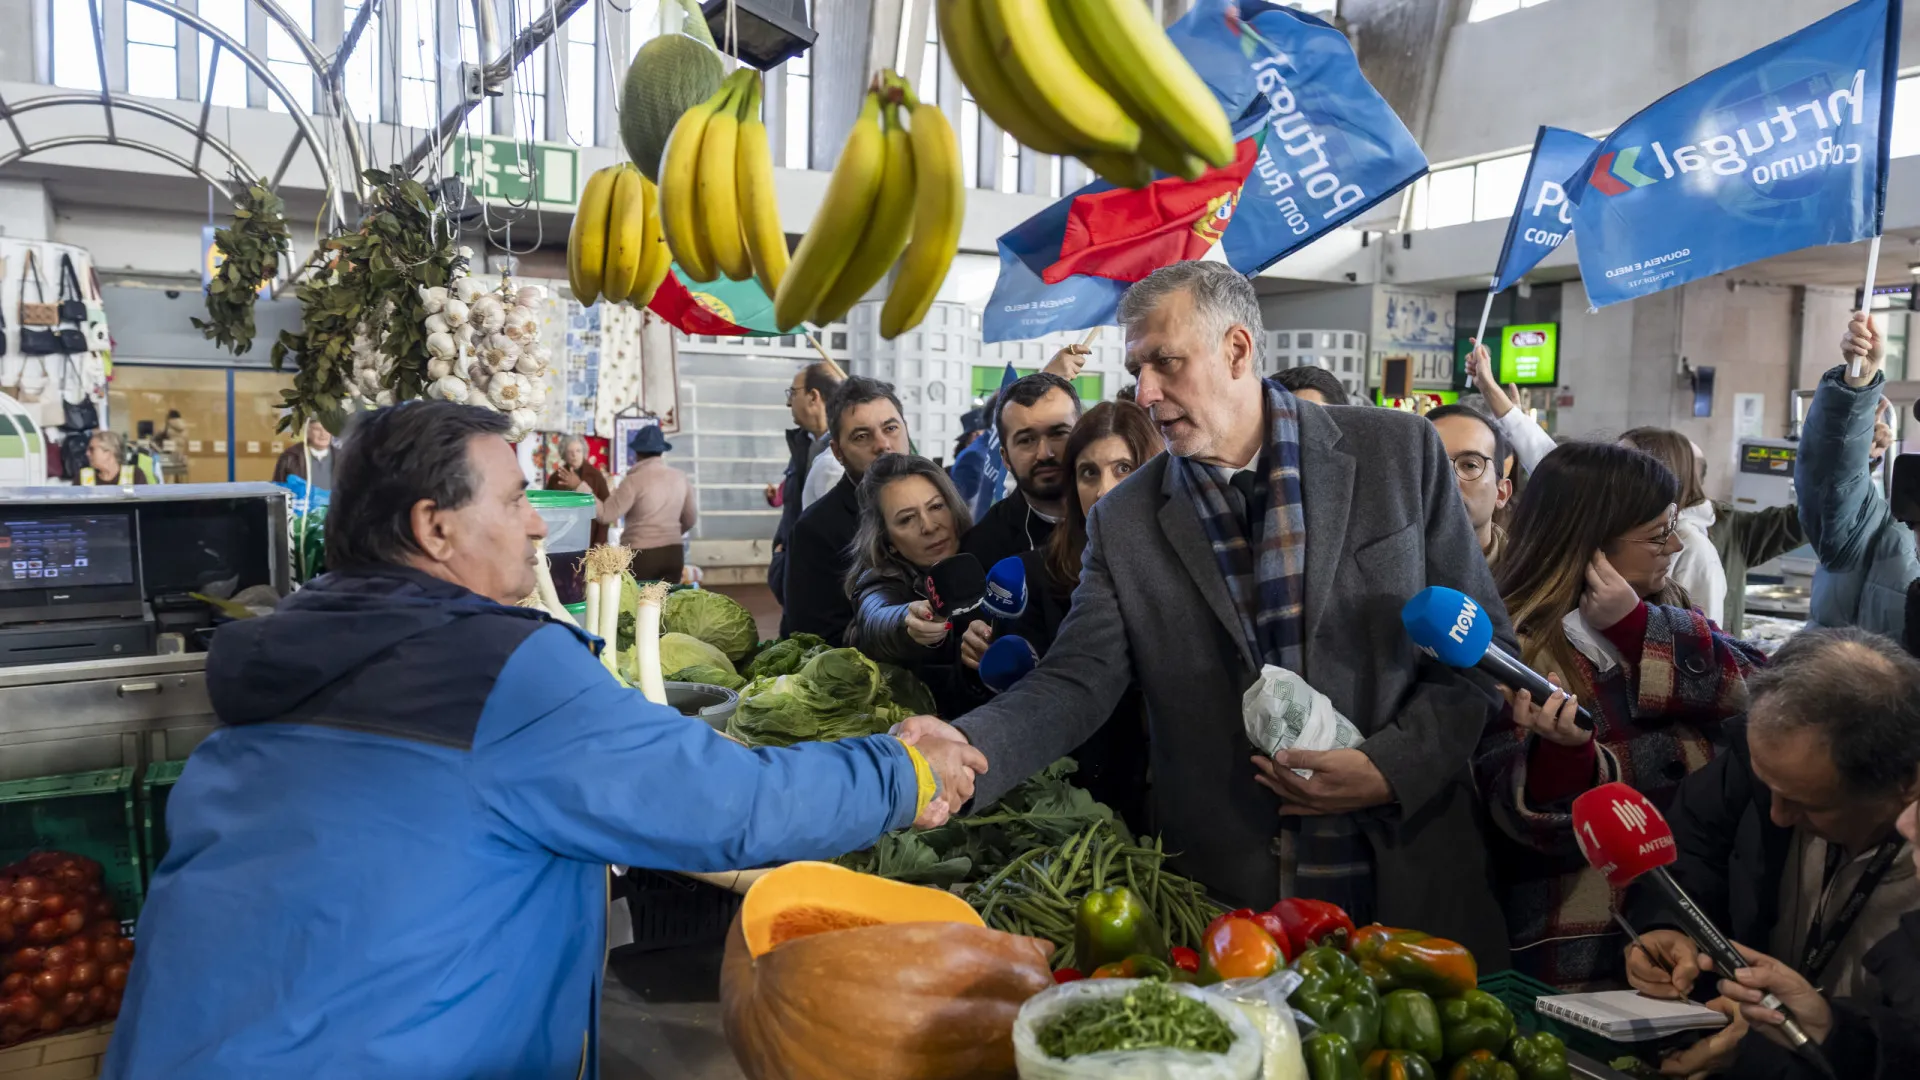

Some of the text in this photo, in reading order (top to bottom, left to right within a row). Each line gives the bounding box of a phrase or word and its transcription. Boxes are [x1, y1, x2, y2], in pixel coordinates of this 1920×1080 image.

[925, 575, 945, 609] CNN
[1448, 596, 1478, 644] now
[1583, 820, 1601, 850] 1
